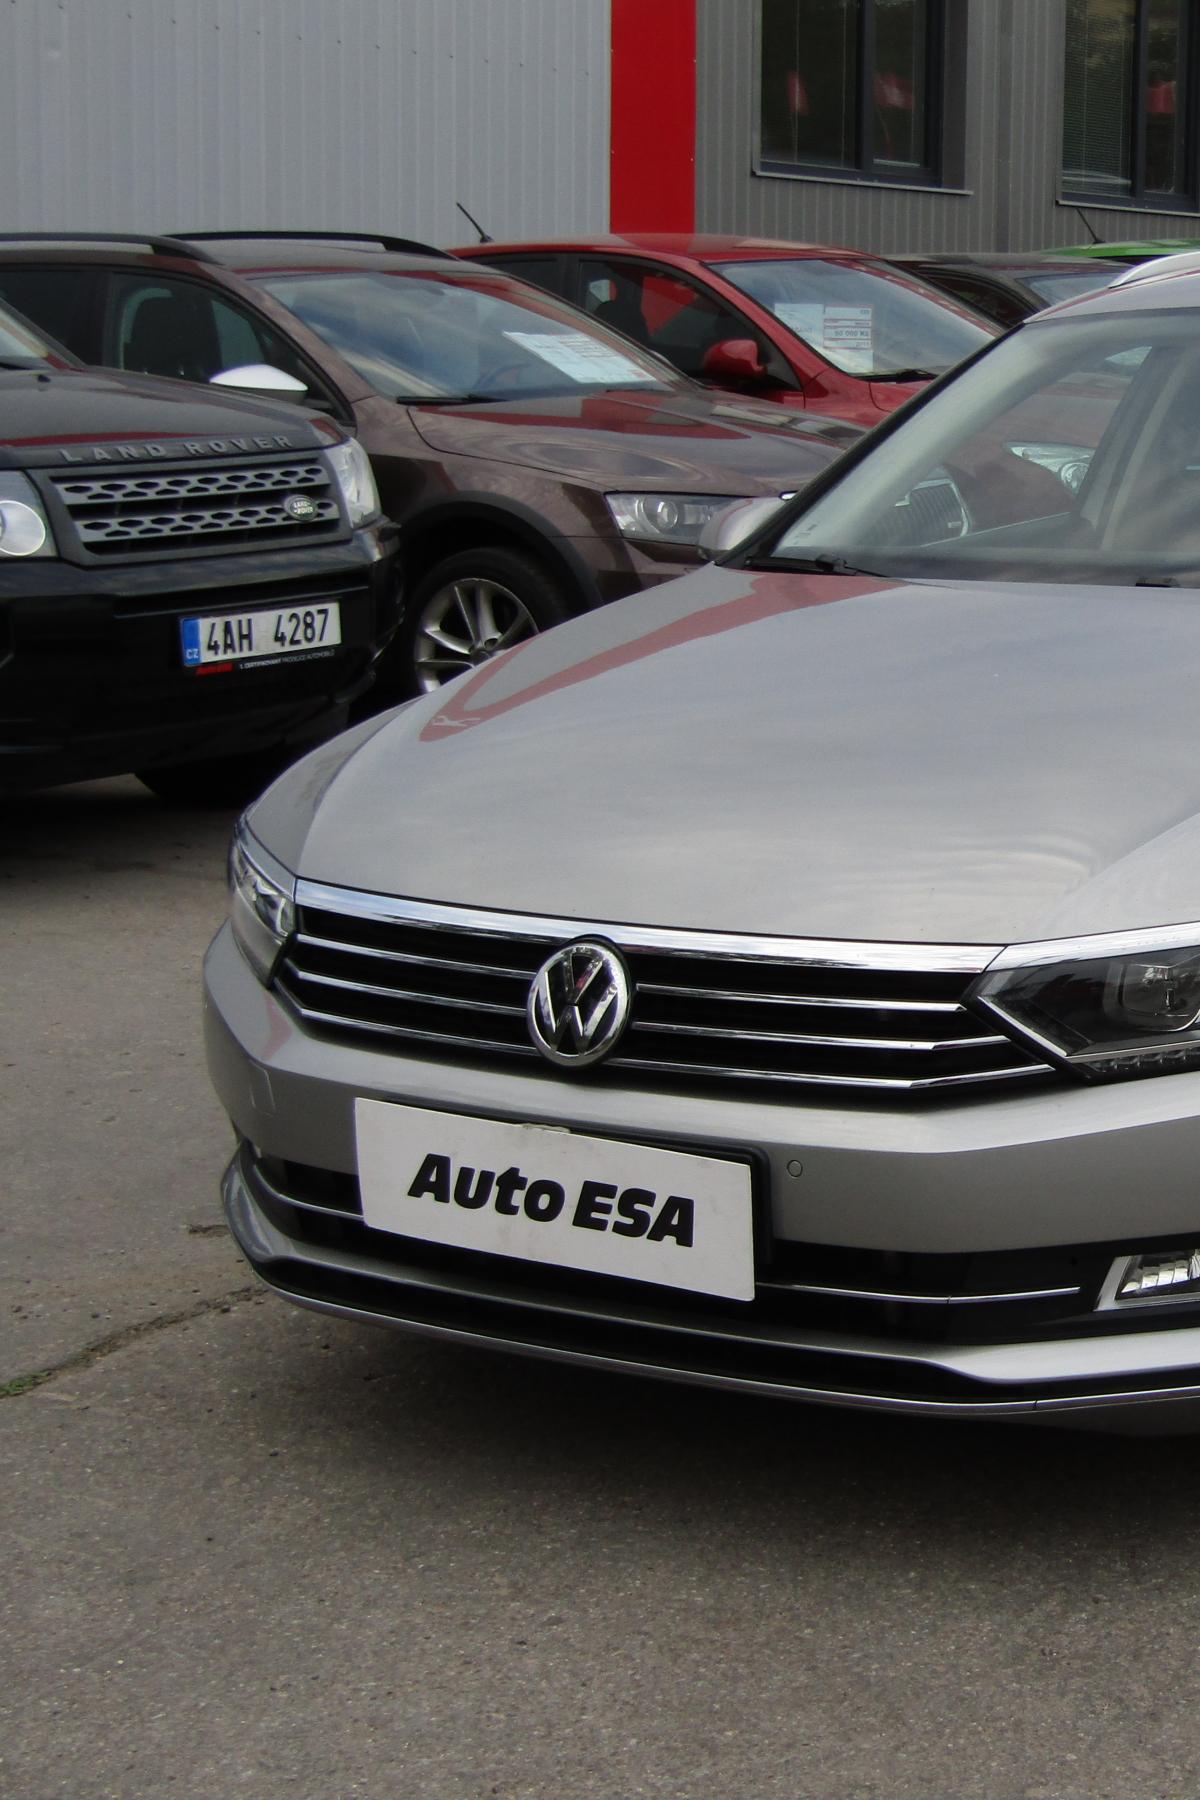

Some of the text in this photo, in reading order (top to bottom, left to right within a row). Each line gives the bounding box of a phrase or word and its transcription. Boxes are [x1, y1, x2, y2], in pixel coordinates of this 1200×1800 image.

[60, 435, 293, 462] LAND ROVER
[207, 608, 329, 656] 4AH 4287
[186, 648, 199, 659] CZ
[407, 1153, 695, 1248] Auto ESA
